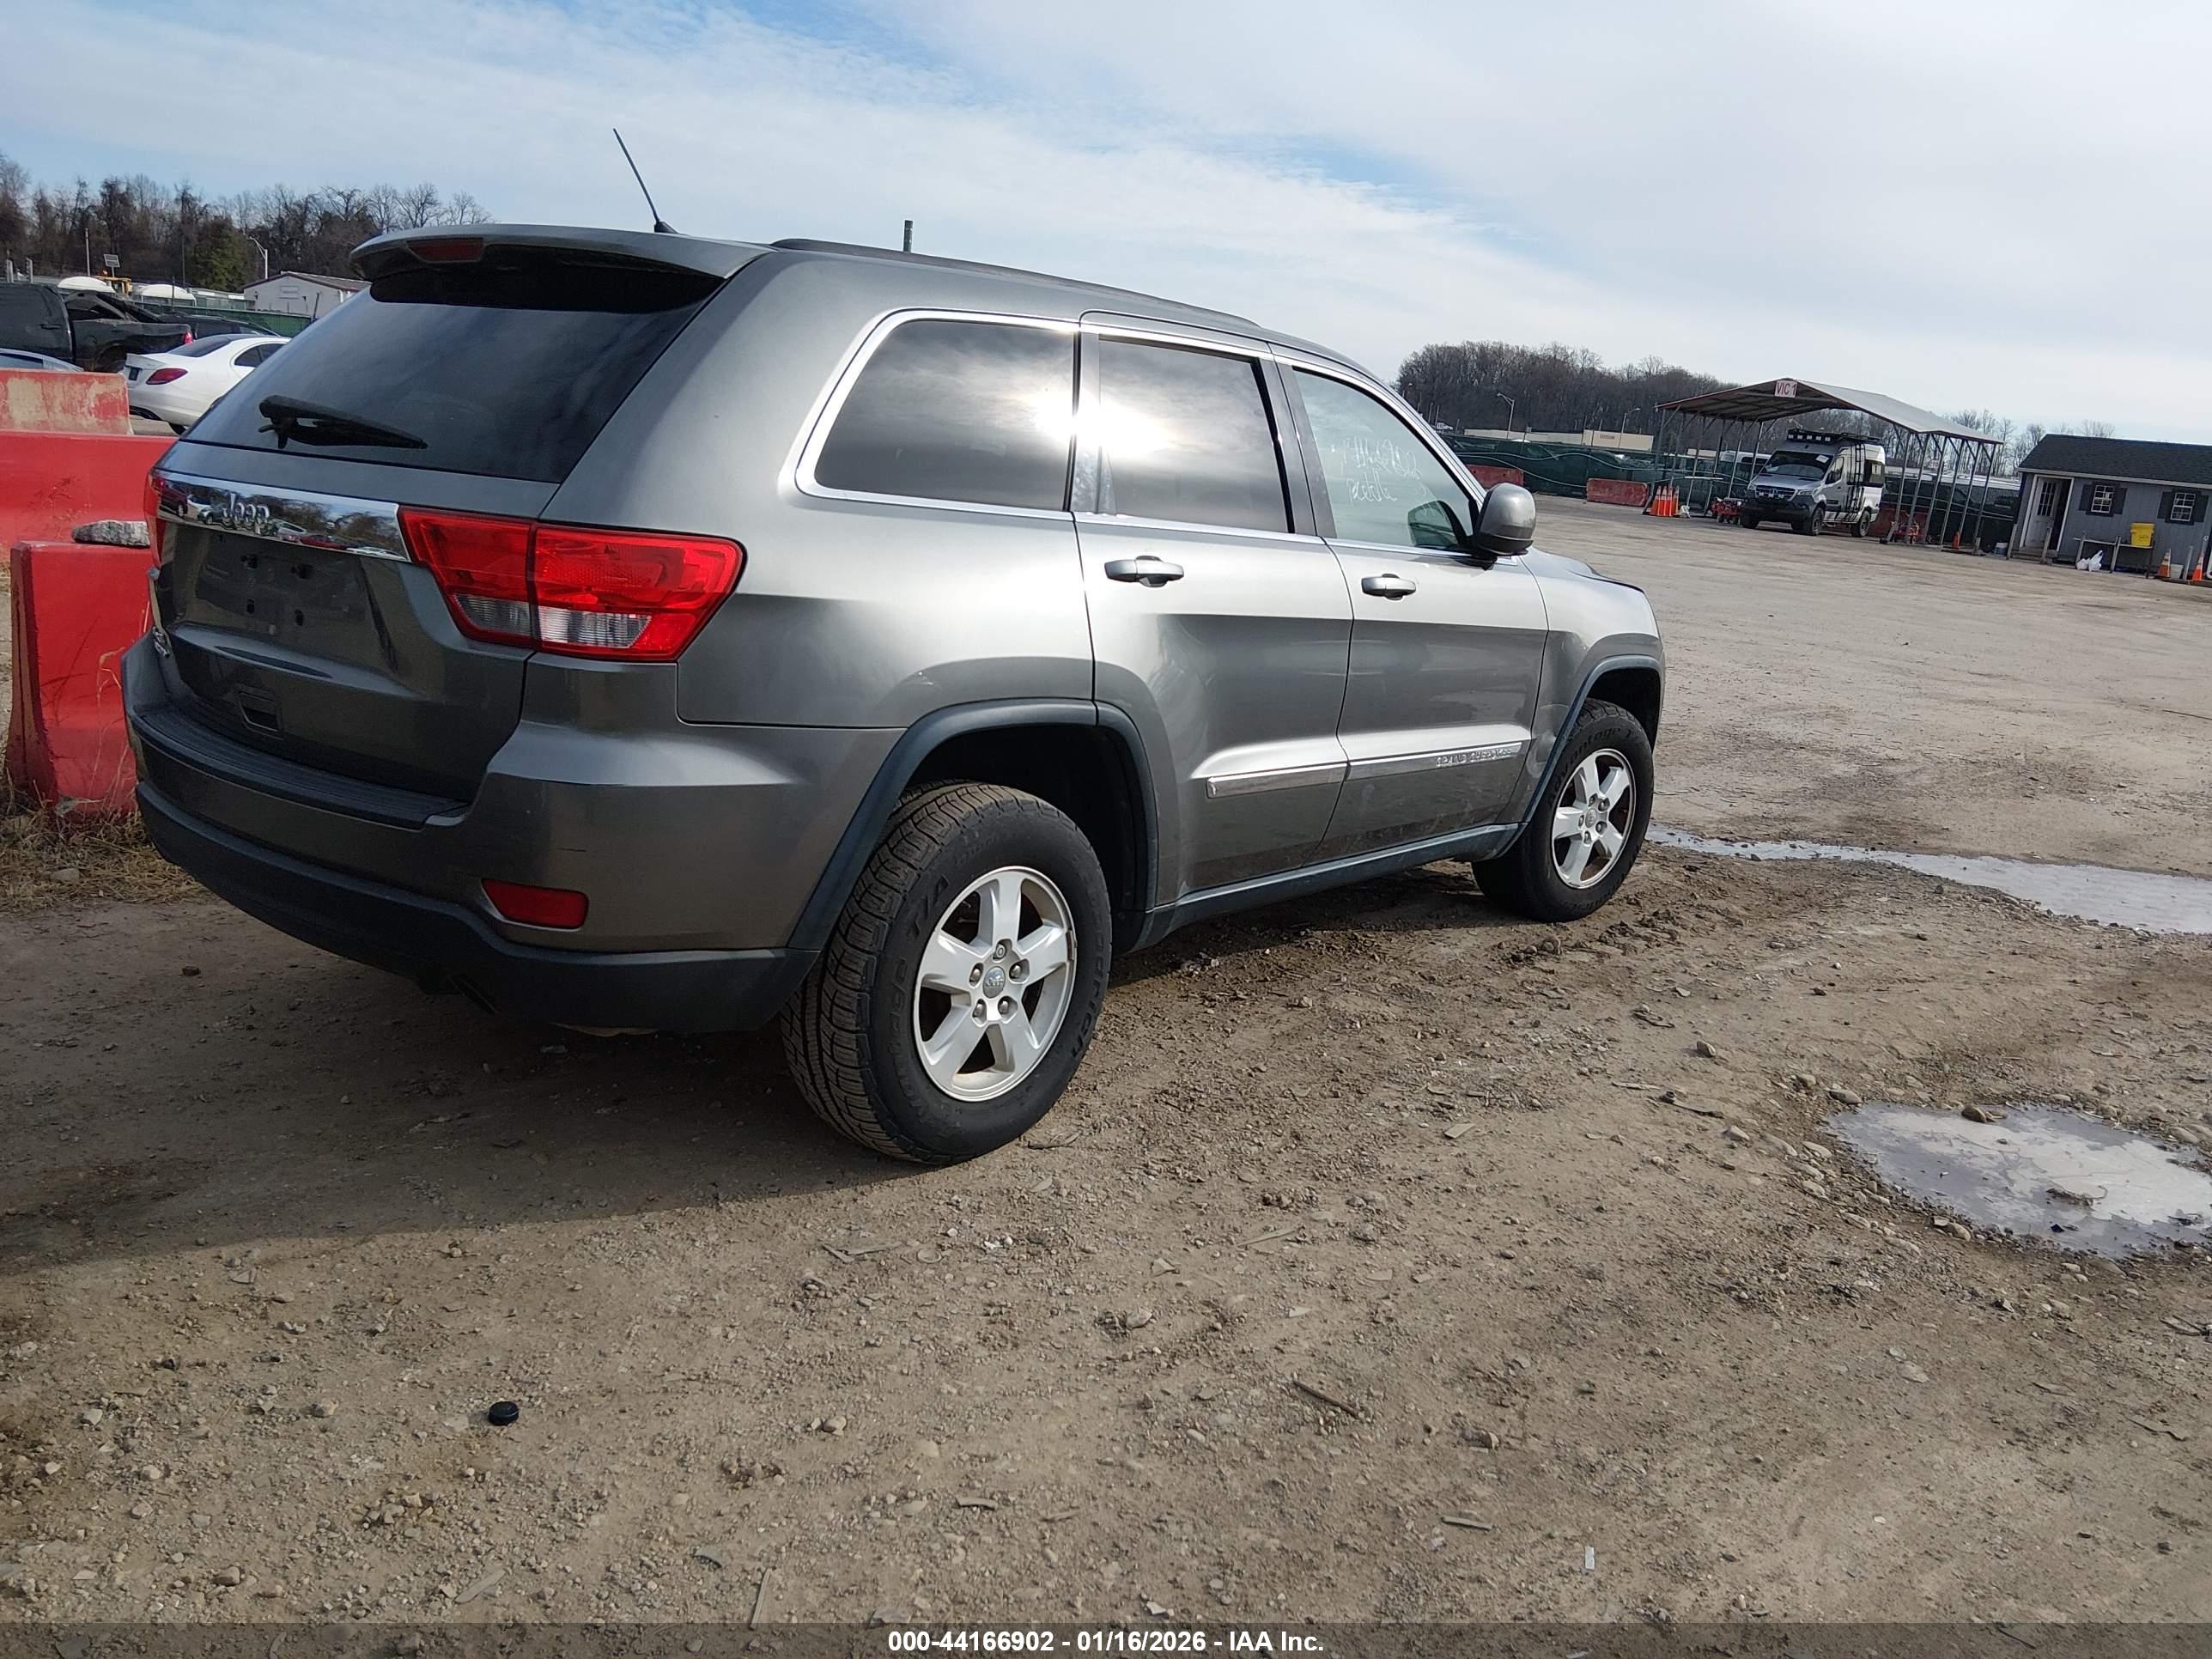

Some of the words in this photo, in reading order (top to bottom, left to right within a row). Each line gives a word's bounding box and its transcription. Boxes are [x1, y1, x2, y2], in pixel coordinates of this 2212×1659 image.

[1777, 383, 1790, 395] VIC
[1791, 384, 1797, 396] 1
[222, 493, 270, 534] Jeep
[1436, 755, 1467, 768] GRAND
[1469, 748, 1512, 763] CHEROKEE
